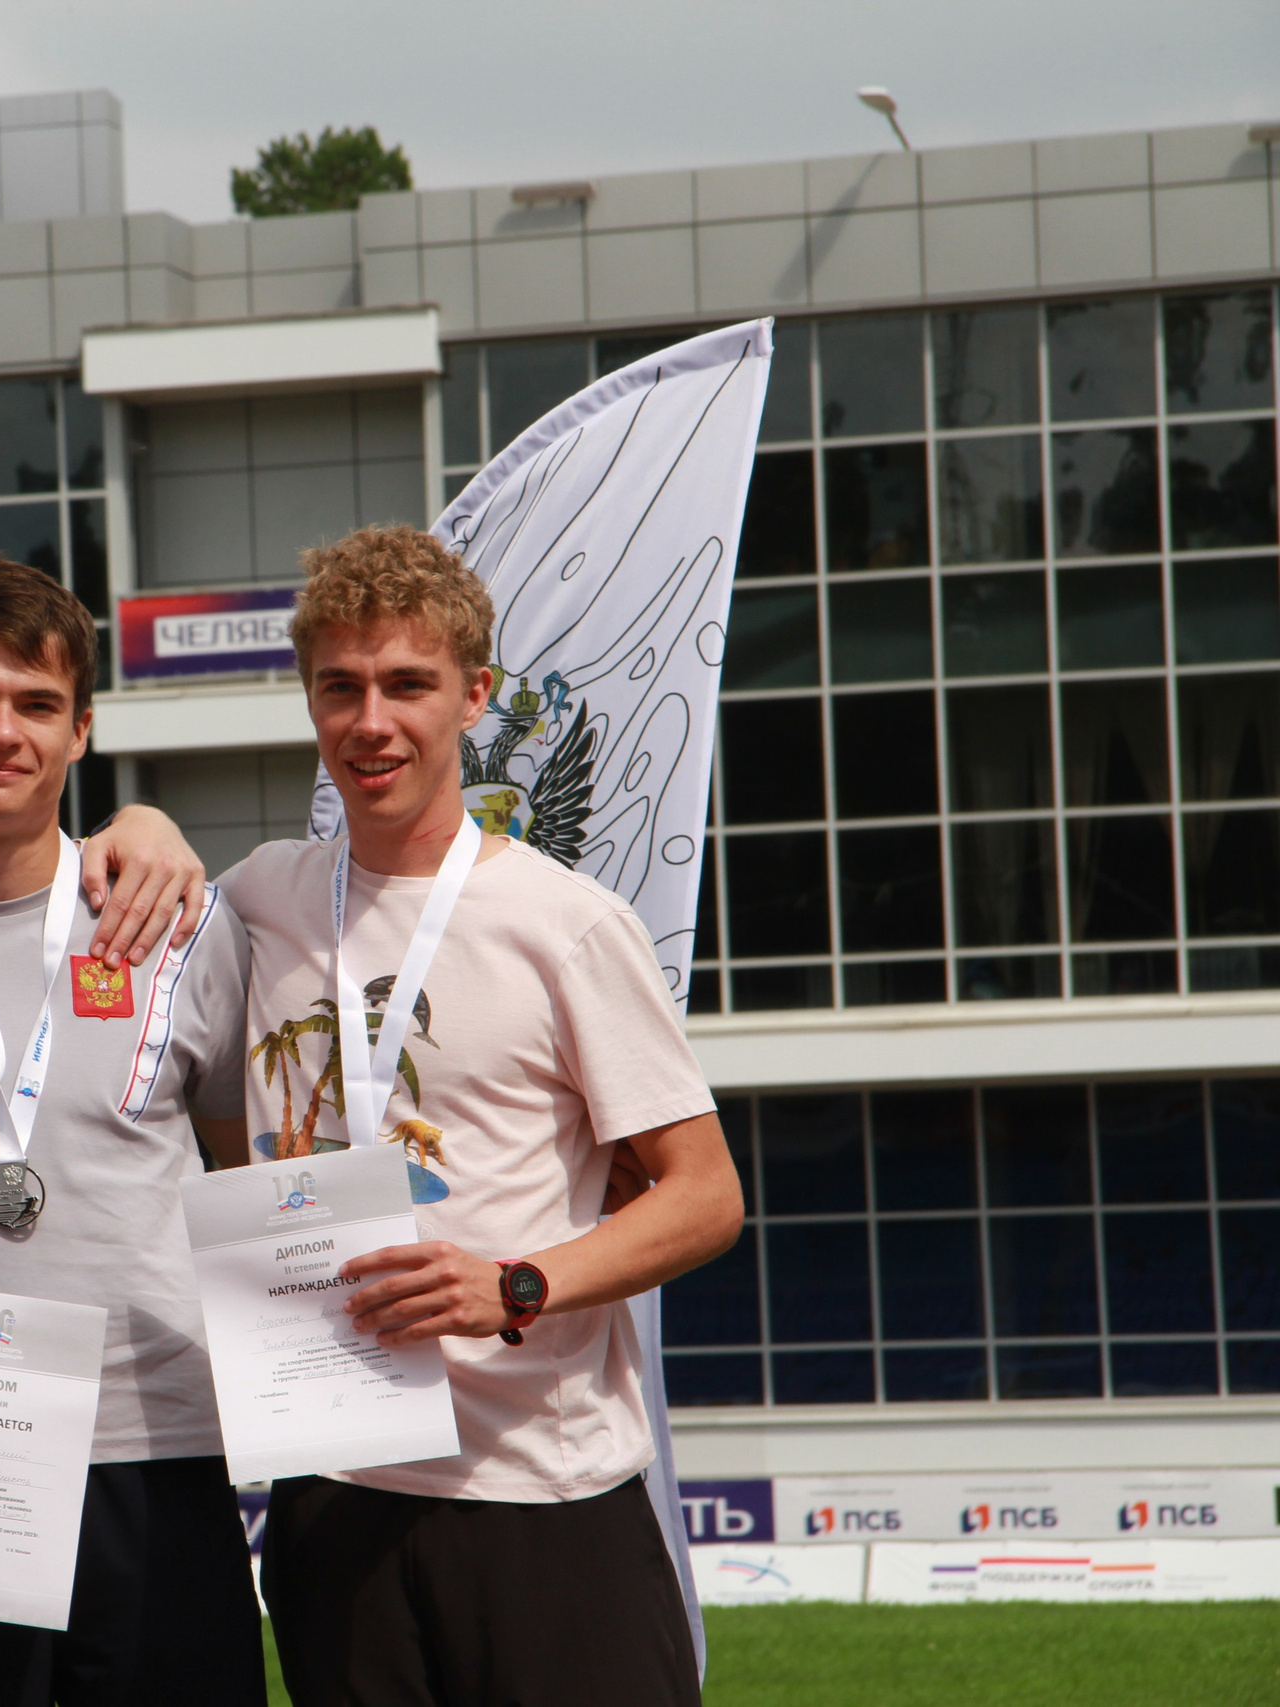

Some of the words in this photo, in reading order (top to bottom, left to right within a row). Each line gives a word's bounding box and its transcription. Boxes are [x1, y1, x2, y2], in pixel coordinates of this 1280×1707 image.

[275, 1239, 335, 1262] ДИПЛОМ
[294, 1261, 331, 1273] степени
[268, 1275, 361, 1298] НАГРАЖДАЕТСЯ
[288, 1356, 328, 1367] спортивному
[329, 1346, 382, 1360] ориентированию
[302, 1346, 338, 1356] Первенстве
[338, 1341, 360, 1349] России
[681, 1497, 755, 1538] ТЬ
[842, 1508, 902, 1532] ПСБ
[998, 1505, 1059, 1529] ПСБ
[1157, 1503, 1218, 1527] ПСБ
[930, 1581, 979, 1592] ФОНД
[980, 1572, 1086, 1584] ПОДДЕРЖКИ
[1088, 1579, 1155, 1591] СПОРТА
